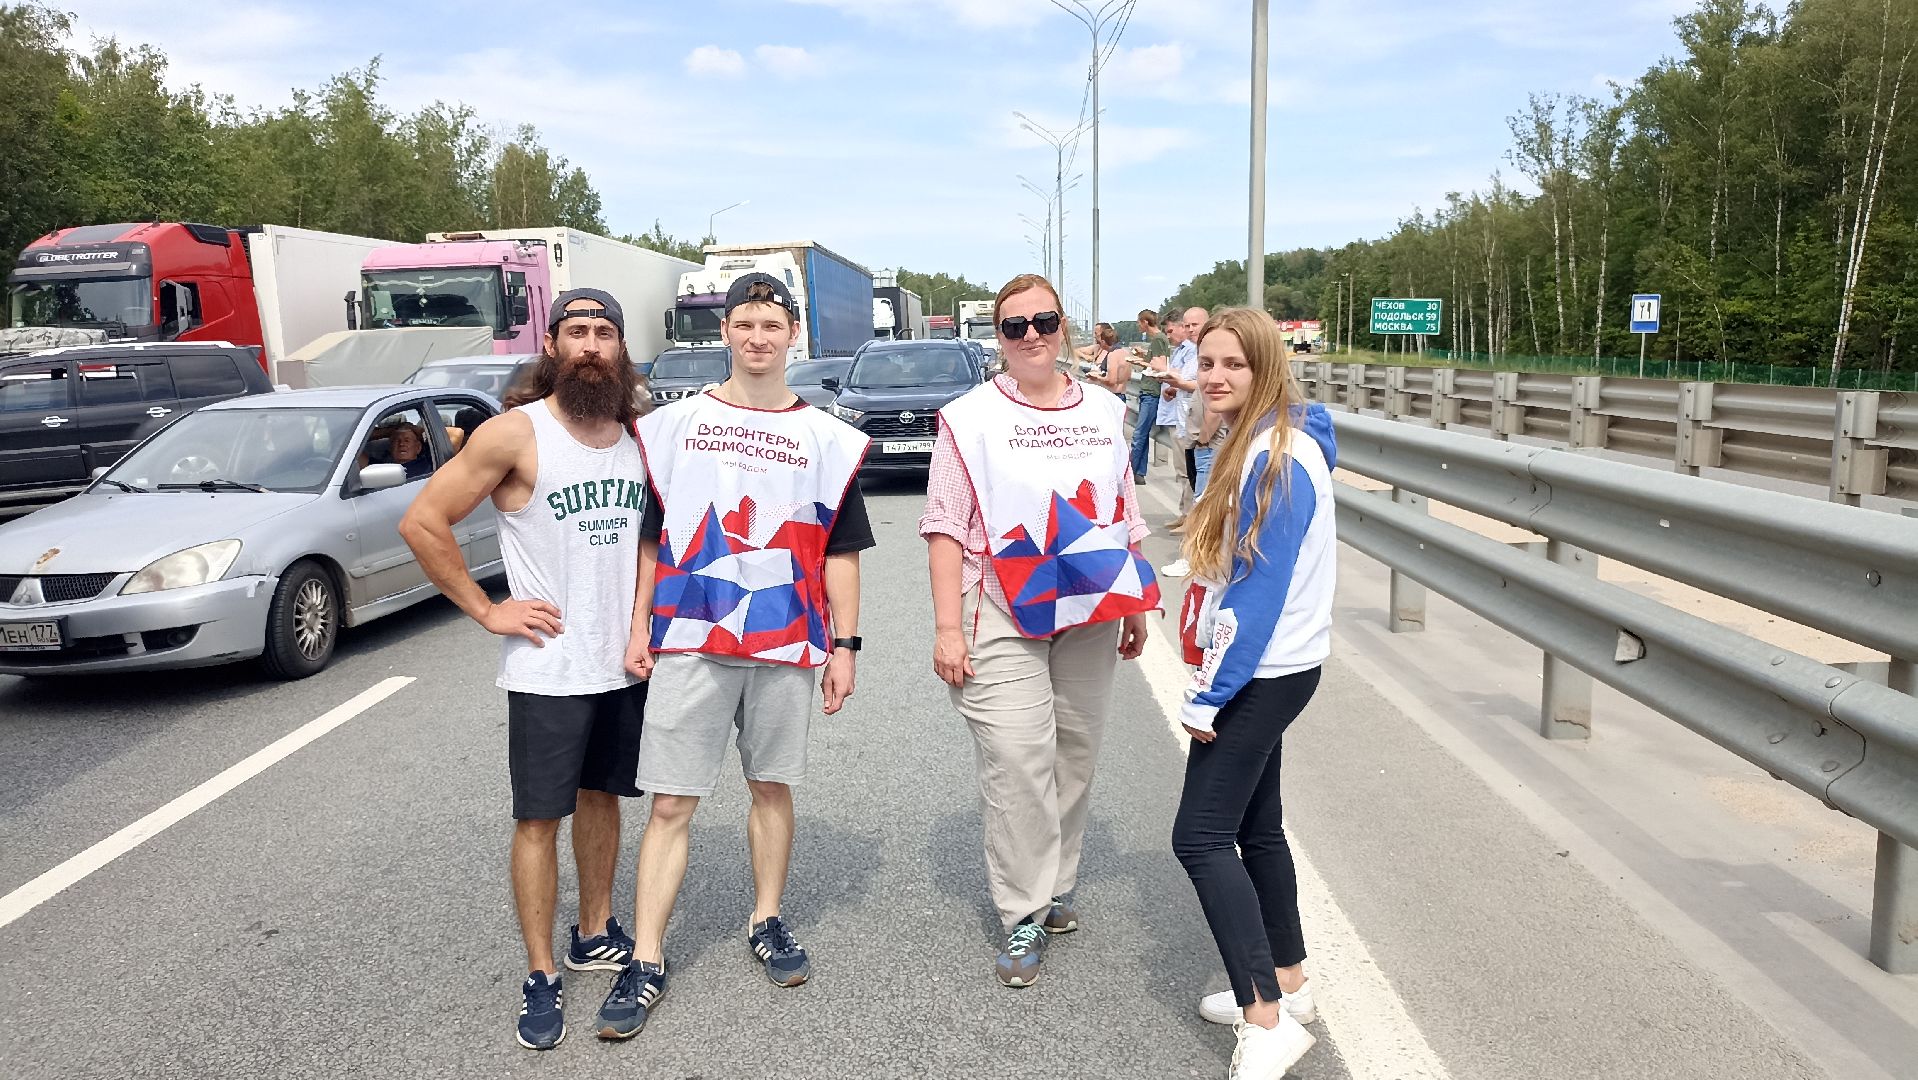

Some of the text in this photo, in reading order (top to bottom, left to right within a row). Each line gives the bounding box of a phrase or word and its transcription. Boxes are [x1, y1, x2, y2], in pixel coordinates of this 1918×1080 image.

[37, 252, 118, 263] GLOBETROTTER
[1375, 301, 1438, 311] ЧЕХОВ 30
[1374, 312, 1437, 321] ПОДОЛЬСК 59
[1374, 322, 1436, 331] МОСКВА 75
[697, 423, 800, 450] ВОЛОНТЕРЫ
[685, 438, 809, 468] ПОДМОСКОВЬЯ
[546, 478, 645, 520] SURFIN
[578, 517, 628, 532] SUMMER
[589, 532, 619, 546] CLUB
[30, 624, 53, 638] 177
